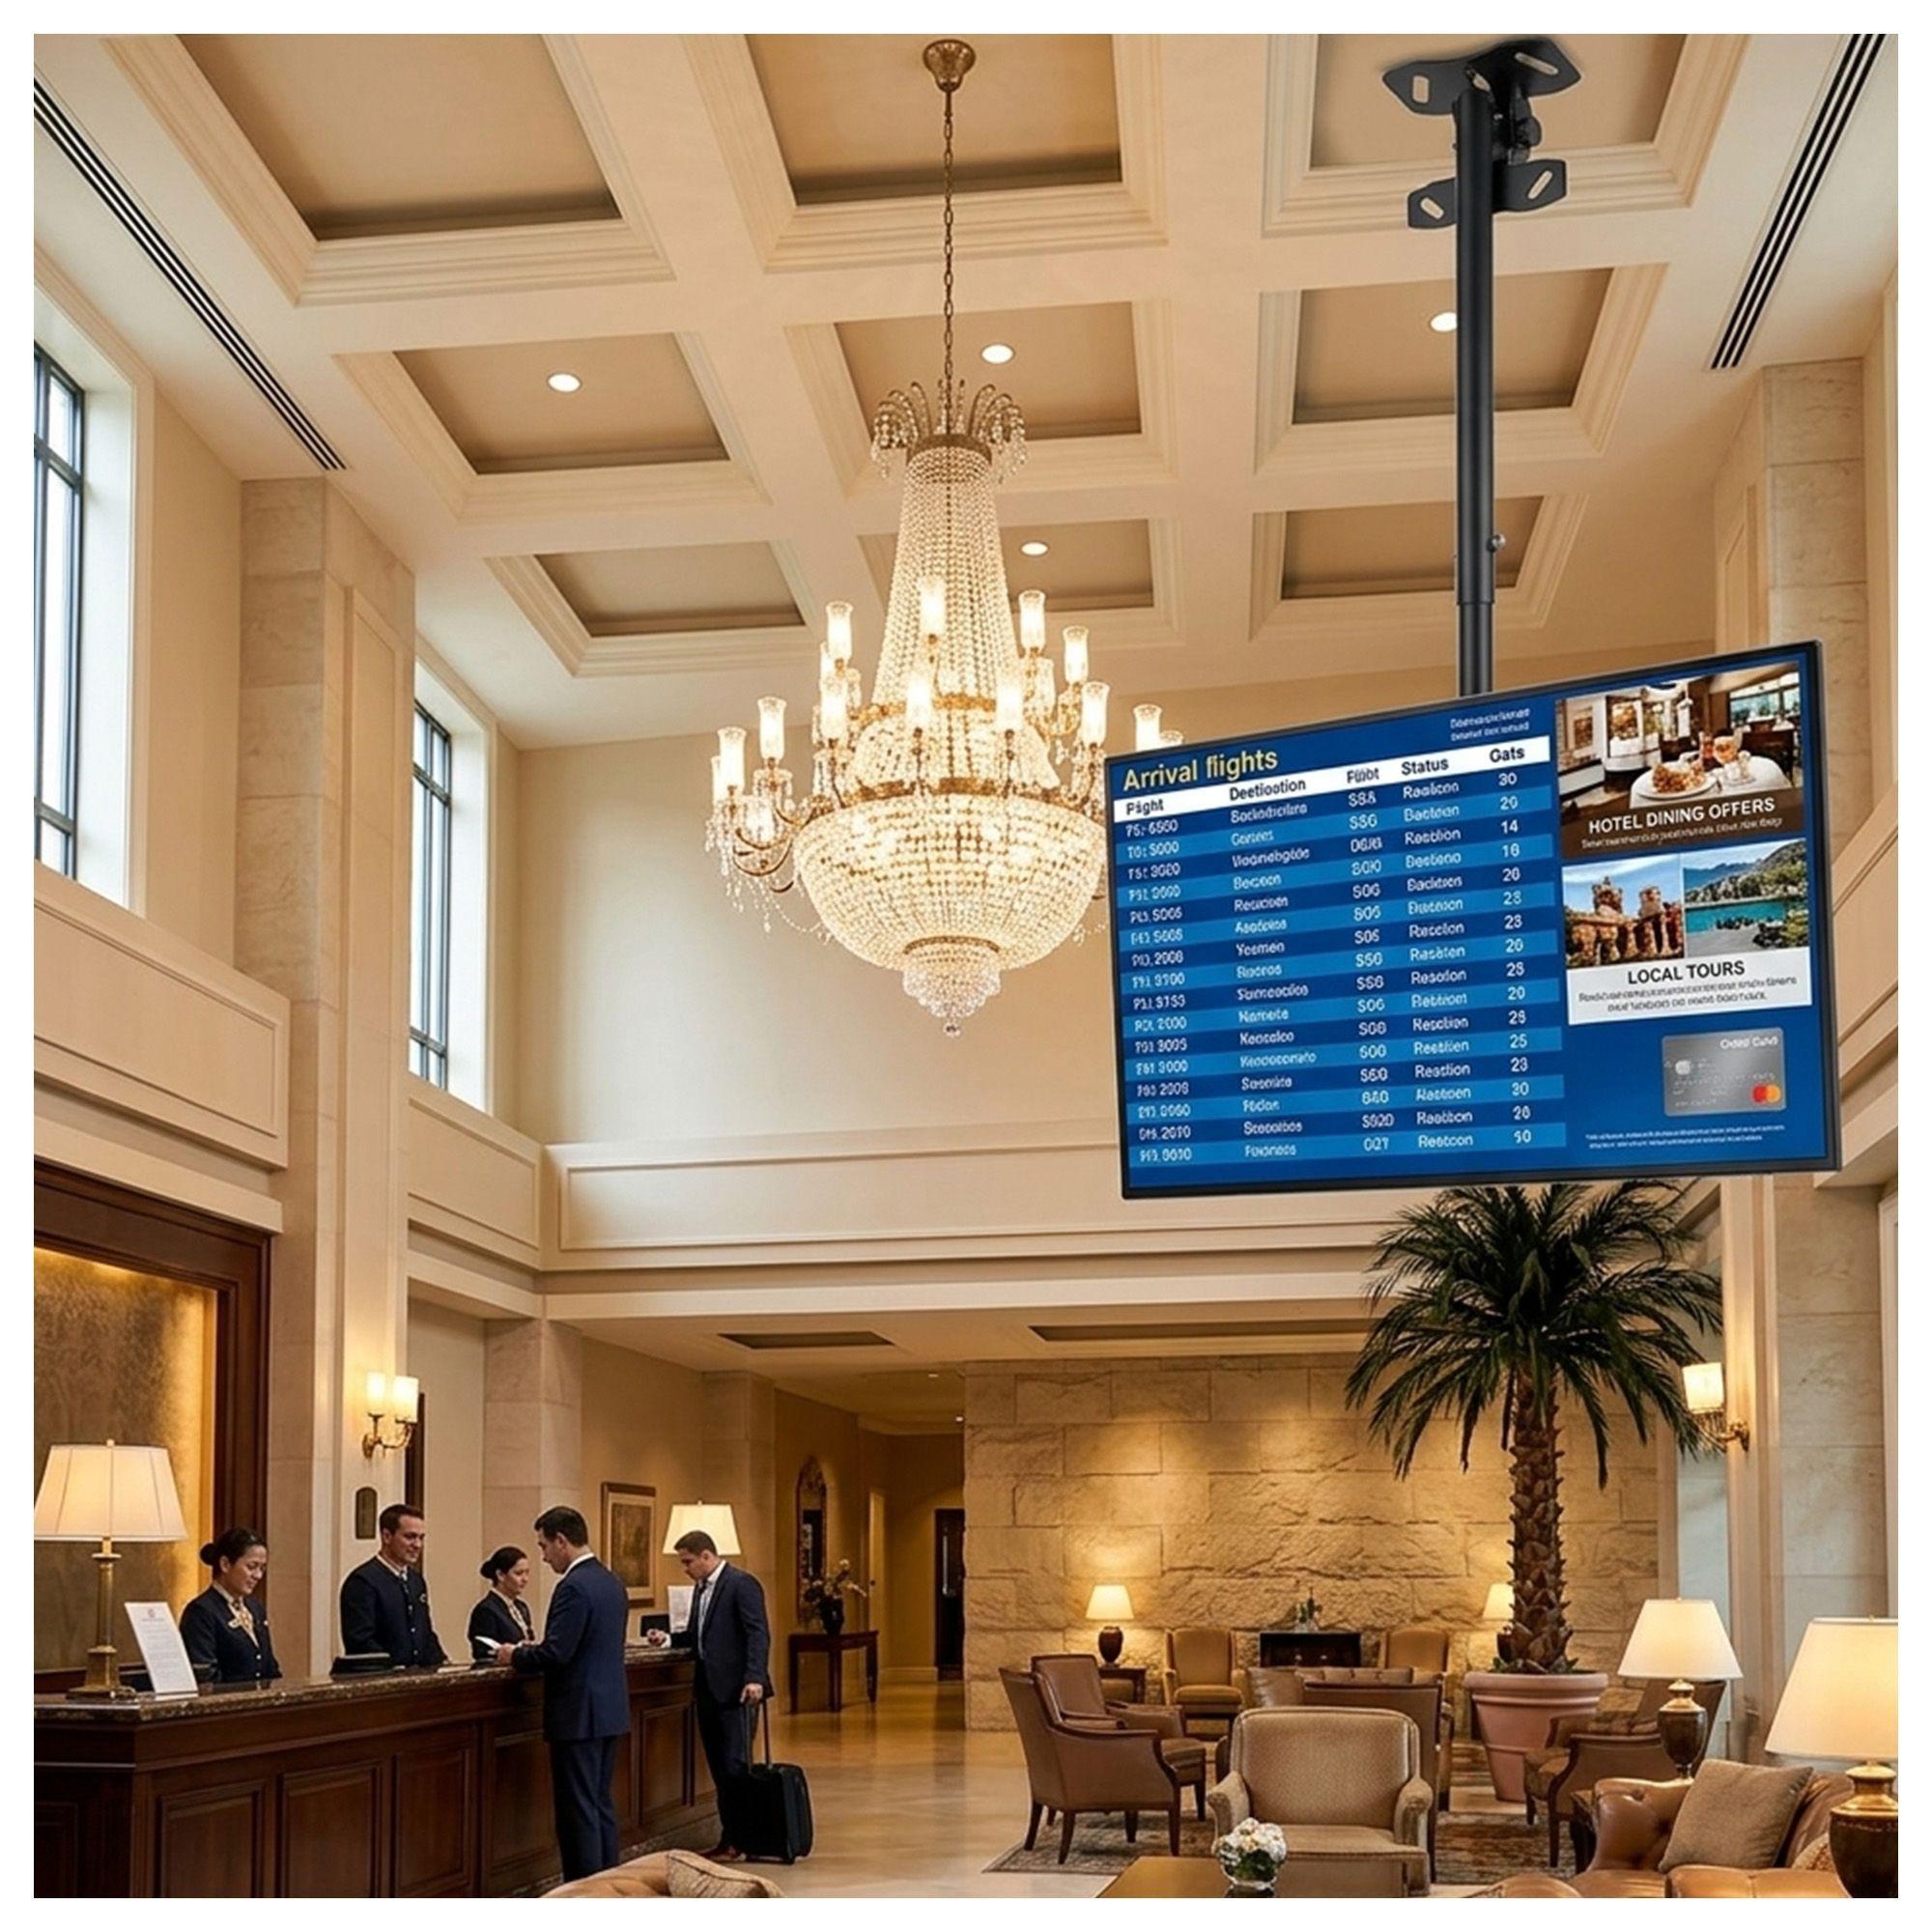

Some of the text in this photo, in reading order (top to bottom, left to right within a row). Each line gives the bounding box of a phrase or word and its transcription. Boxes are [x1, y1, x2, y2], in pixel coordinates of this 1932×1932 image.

[1123, 759, 1197, 790] Arrival
[1402, 758, 1449, 776] Status
[1499, 773, 1517, 785] 30
[1589, 817, 1642, 835] HOTEL
[1646, 807, 1704, 827] DINING
[1709, 797, 1776, 819] OFFERS
[1501, 820, 1518, 834] 14
[1628, 961, 1745, 984] LOCAL TOURS
